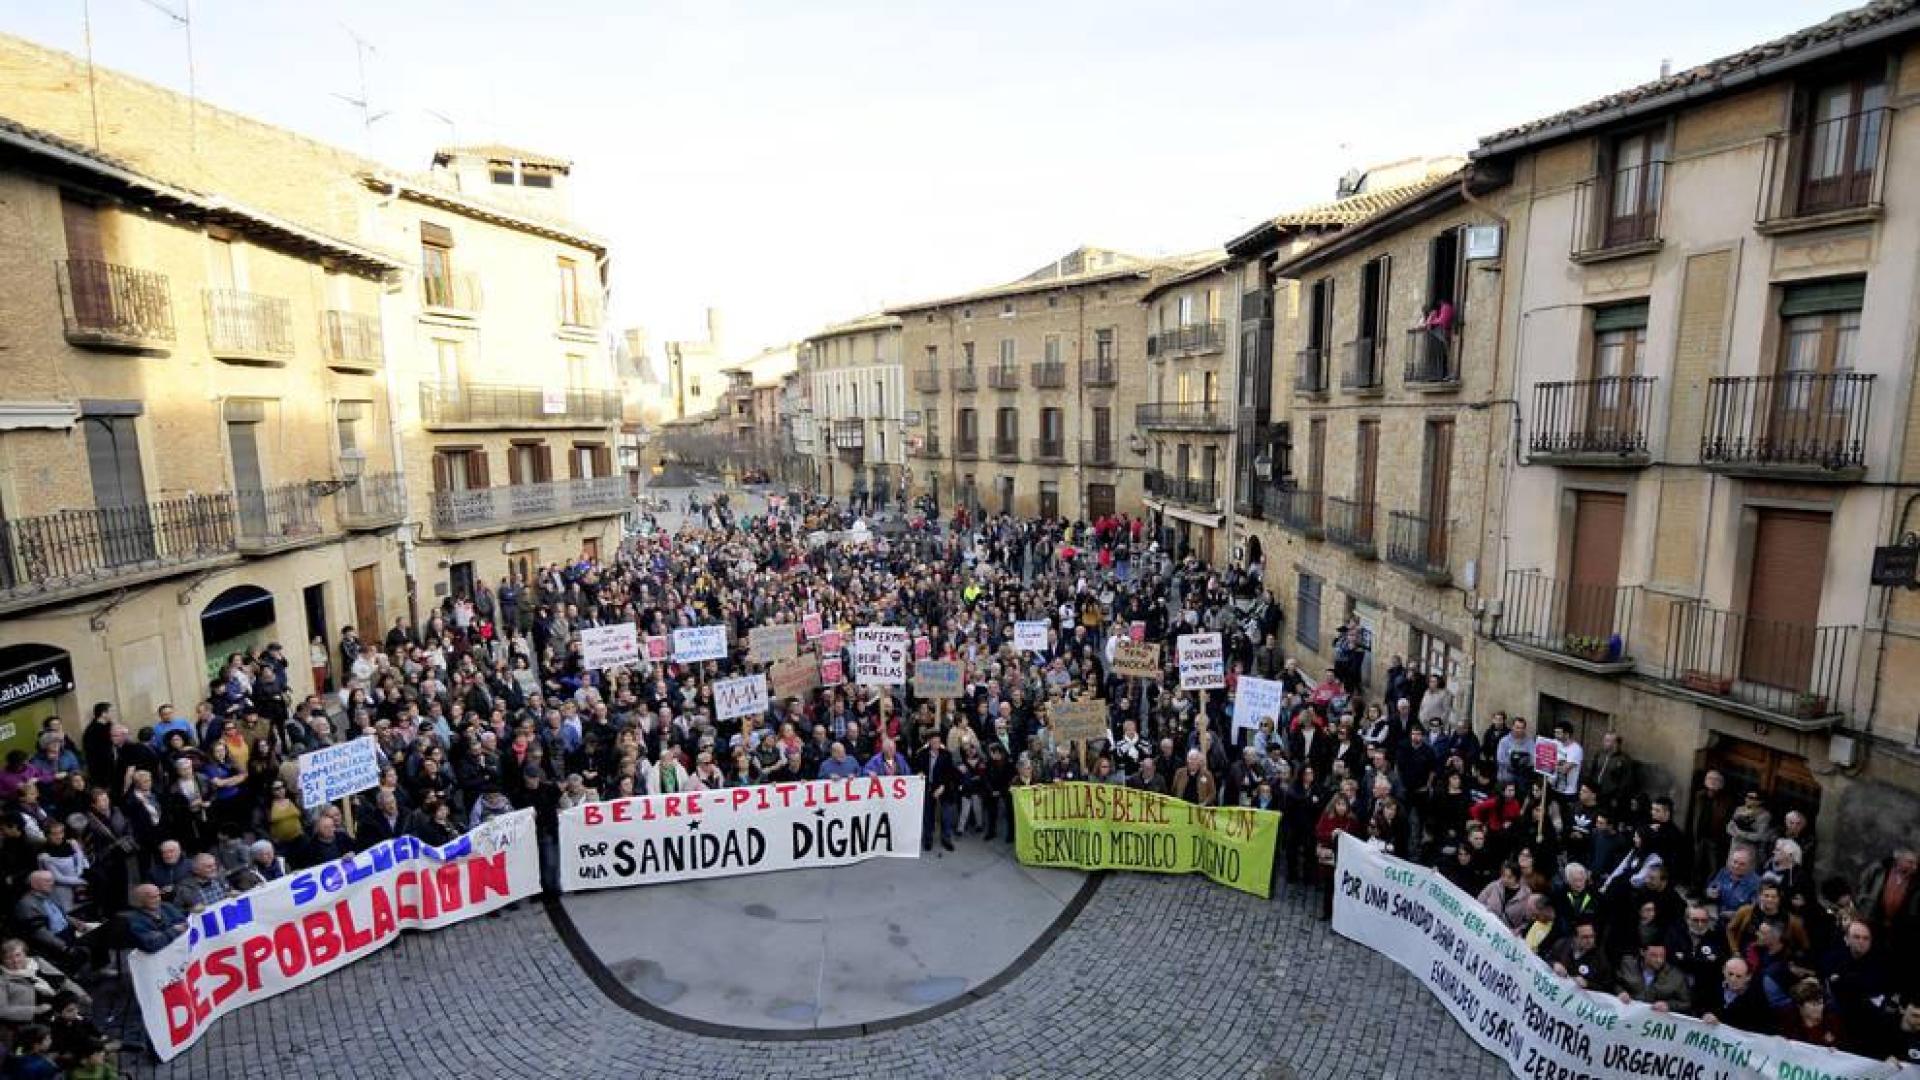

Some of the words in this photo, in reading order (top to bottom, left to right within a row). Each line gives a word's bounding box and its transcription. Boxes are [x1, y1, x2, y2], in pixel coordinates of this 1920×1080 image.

[0, 667, 62, 701] aixaBank
[1033, 828, 1101, 866] SERVICIO
[1110, 831, 1176, 868] MEDICO
[1192, 835, 1240, 882] DIGNO
[1341, 868, 1362, 900] POR
[1364, 884, 1389, 912] UNA
[162, 852, 510, 1047] DESPOBLACION
[1641, 1020, 1678, 1041] SAN
[1684, 1030, 1752, 1068] MARTÍN
